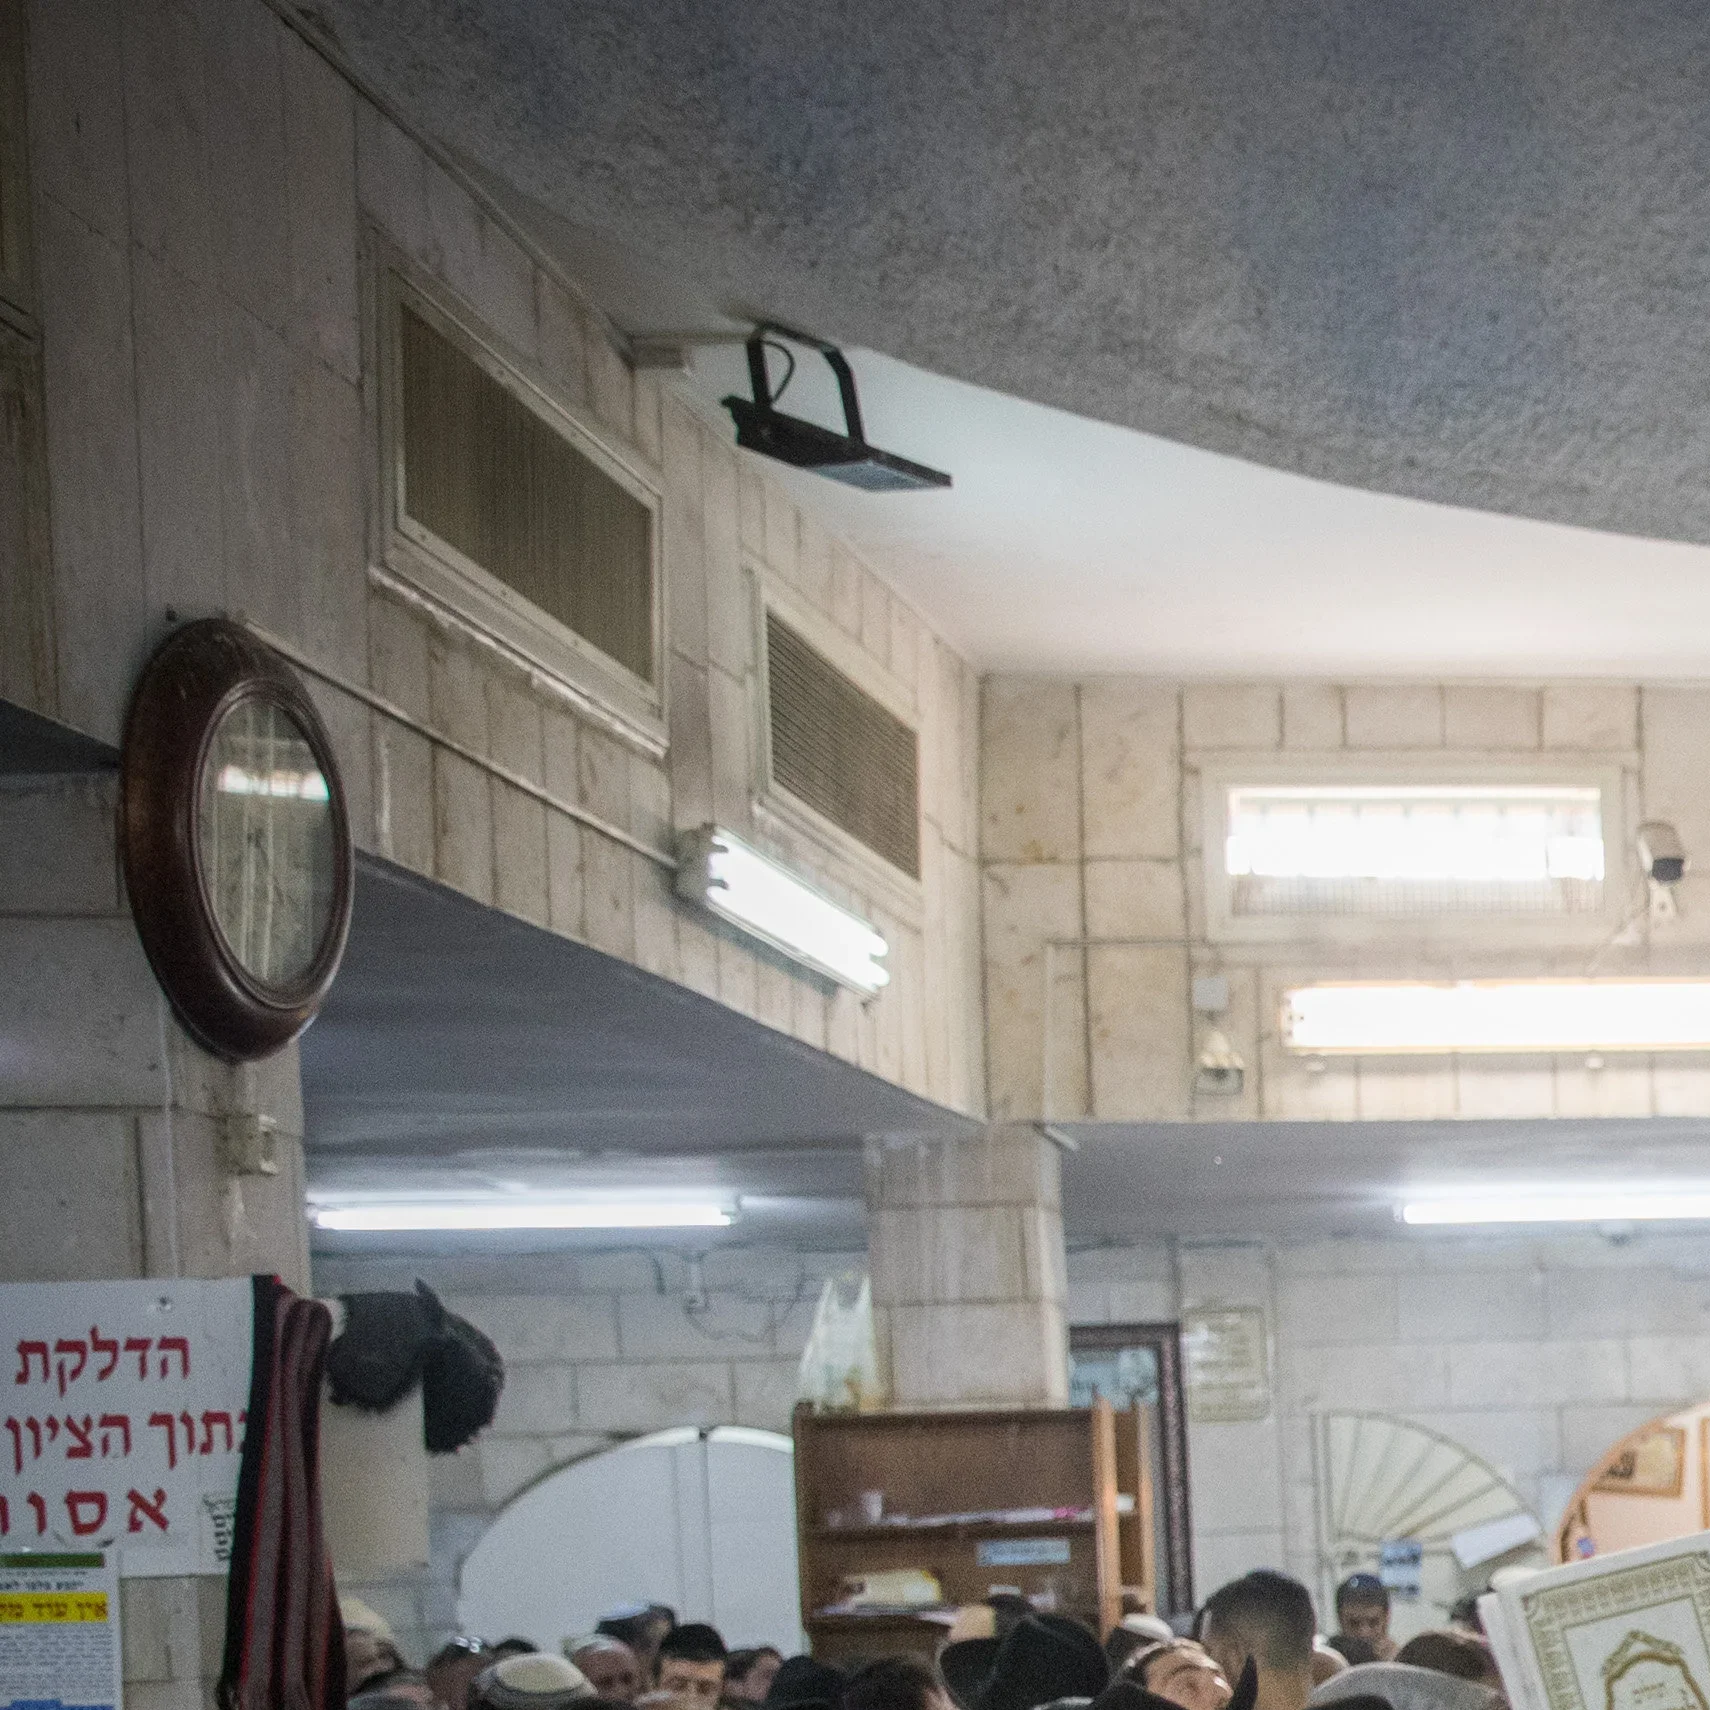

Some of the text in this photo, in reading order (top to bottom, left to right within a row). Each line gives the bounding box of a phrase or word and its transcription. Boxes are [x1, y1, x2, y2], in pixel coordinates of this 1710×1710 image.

[15, 1325, 190, 1398] הדלקת
[5, 1409, 247, 1475] תוך הציון
